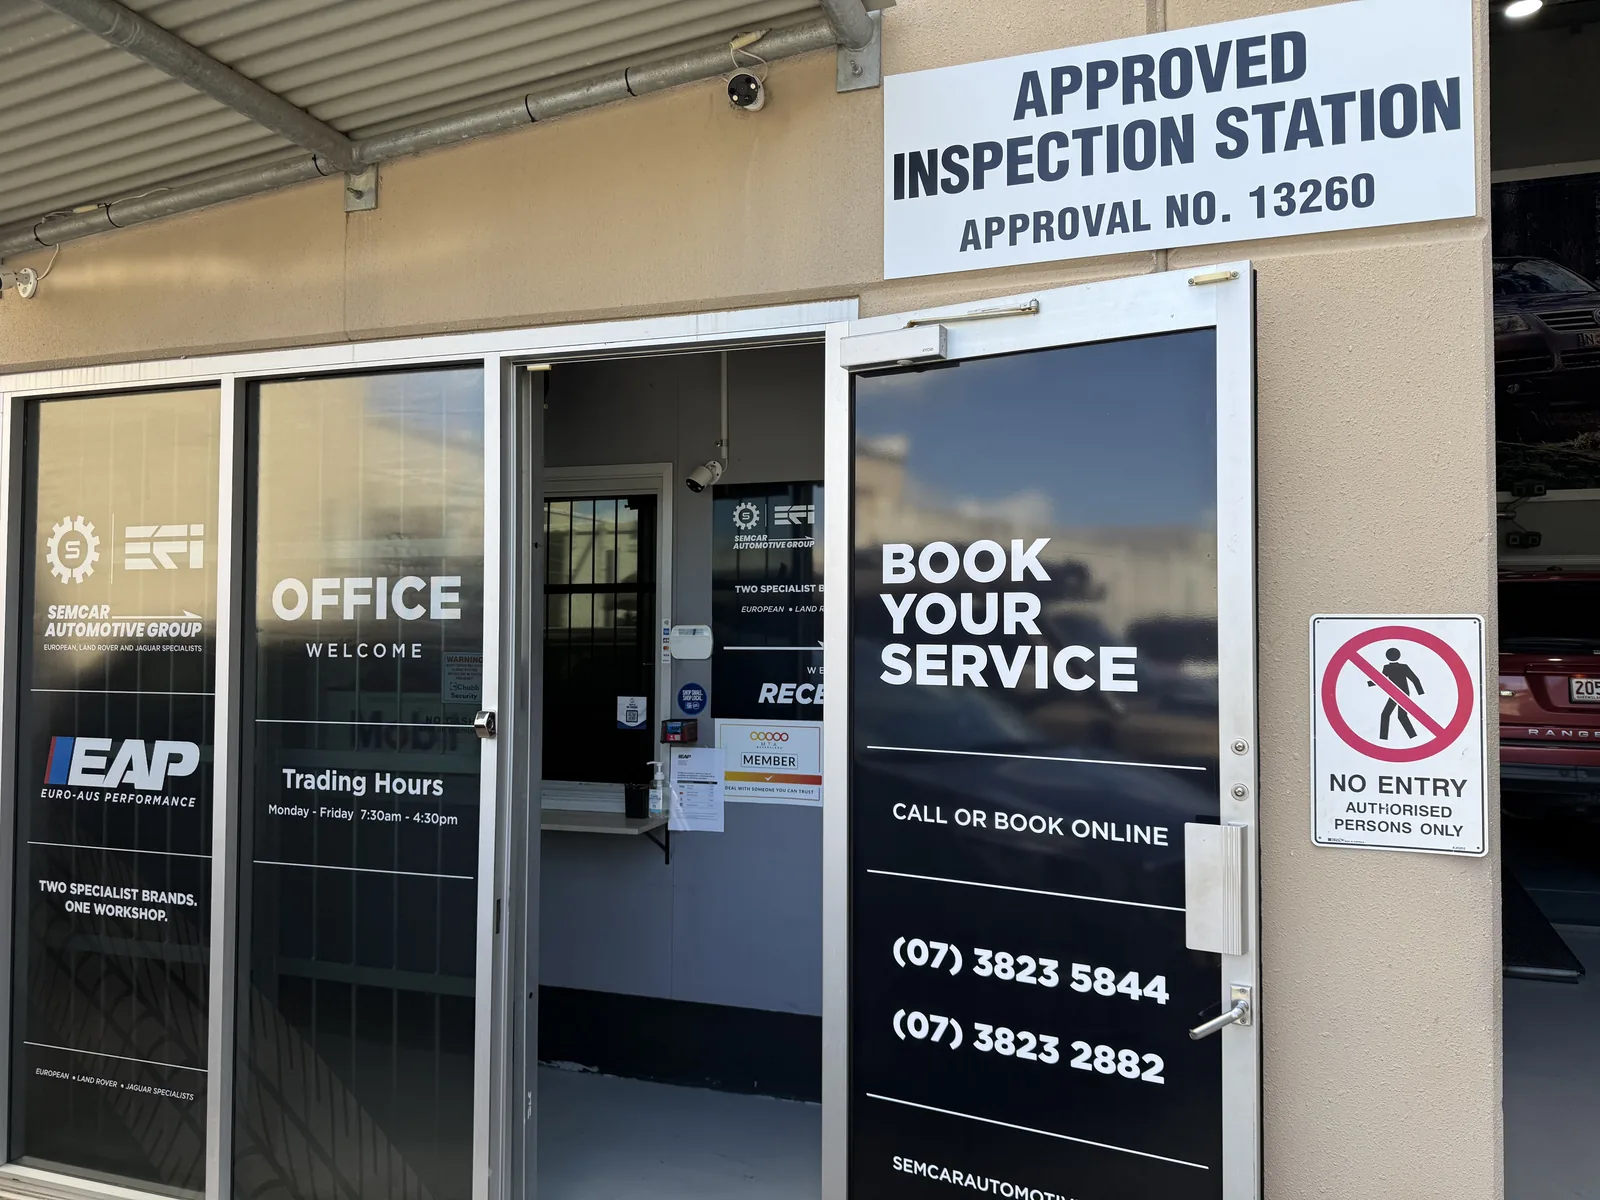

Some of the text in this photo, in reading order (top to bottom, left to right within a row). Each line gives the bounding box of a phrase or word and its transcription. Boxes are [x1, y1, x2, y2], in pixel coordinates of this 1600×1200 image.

[1013, 30, 1307, 120] APPROVED
[893, 76, 1461, 200] INSPECTION STATION
[959, 172, 1375, 253] APPROVAL NO. 13260
[733, 541, 815, 550] AUTOMOTIVE GROUP
[734, 534, 767, 542] SEMCAR
[882, 537, 1052, 584] BOOK
[272, 576, 461, 621] OFFICE
[735, 585, 758, 593] TWO
[760, 584, 816, 593] SPECIALIST
[47, 604, 110, 620] SEMCAR
[795, 605, 817, 613] LAND
[879, 592, 1042, 635] YOUR
[44, 622, 203, 638] AUTOMOTIVE GROUP
[306, 643, 422, 658] WELCOME
[879, 643, 1138, 692] SERVICE
[450, 692, 478, 701] Security
[743, 754, 796, 767] MEMBER
[282, 768, 444, 797] Trading Hours
[1330, 773, 1467, 798] NO ENTRY
[40, 788, 197, 808] EURO-AUS PERFORMANCE
[1345, 801, 1453, 818] AUTHORISED
[268, 803, 310, 819] Monday
[319, 806, 354, 821] Friday
[360, 809, 402, 822] 7:30am
[412, 812, 458, 826] 4:30pm
[892, 802, 1169, 847] CALL OR BOOK ONLINE
[1334, 818, 1463, 837] PERSONS ONLY
[39, 879, 198, 907] TWO SPECIALIST BRANDS.
[65, 900, 168, 922] ONE WORKSHOP.
[892, 936, 1170, 1005] (07) 3823 5844
[892, 1008, 1165, 1085] (07) 3823 2882
[35, 1067, 194, 1101] EUROPEAN LAND ROVER JAGUAR SPECIALISTS
